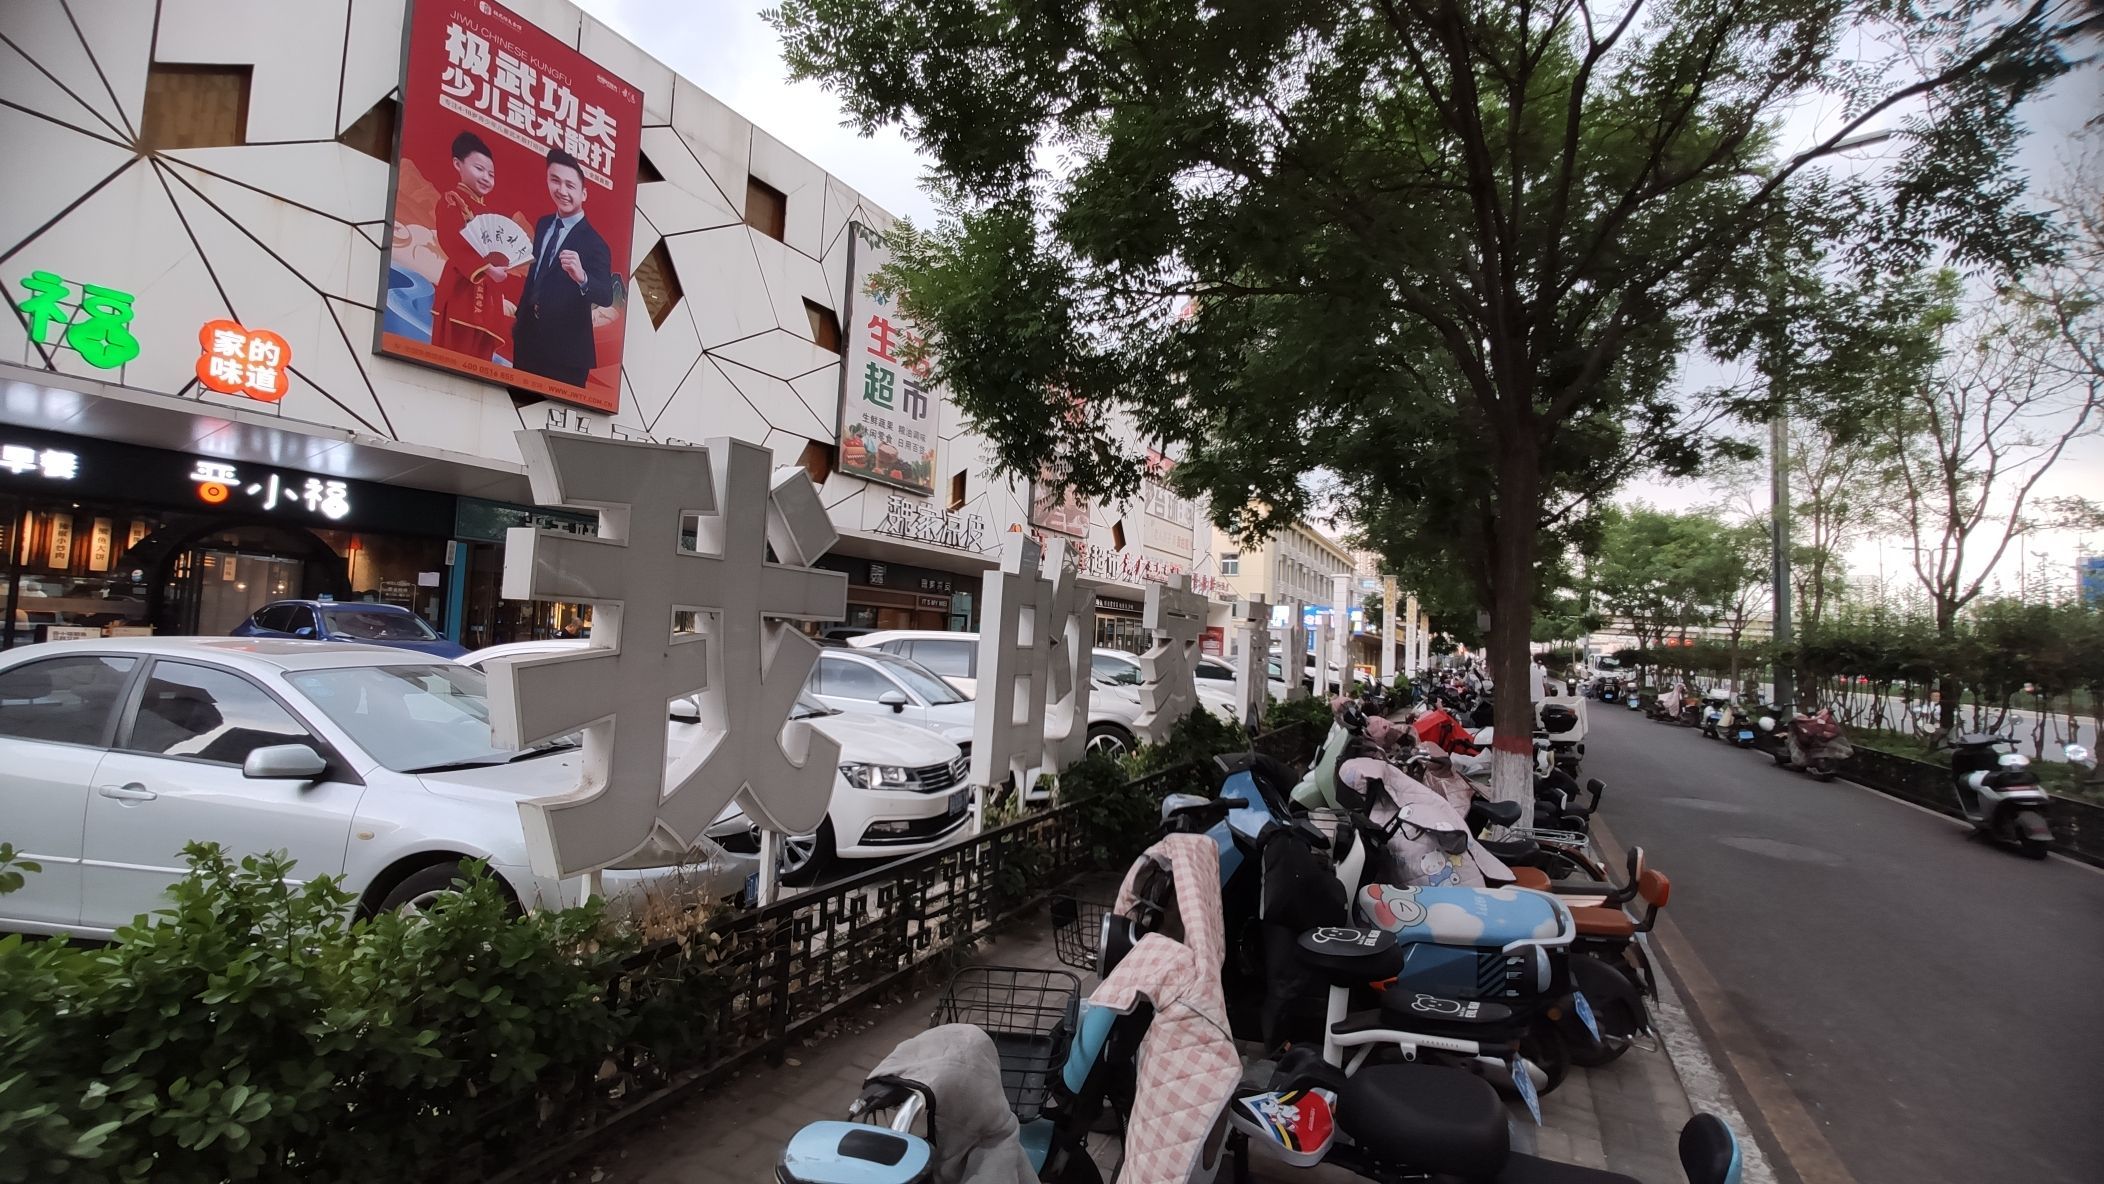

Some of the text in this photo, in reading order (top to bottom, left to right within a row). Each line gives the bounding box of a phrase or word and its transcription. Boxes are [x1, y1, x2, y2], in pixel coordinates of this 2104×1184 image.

[449, 10, 479, 32] JIWU
[480, 27, 528, 61] CHINESE
[530, 55, 573, 87] KUNGFU
[444, 22, 617, 151] 极武功夫
[440, 66, 616, 176] 少儿武术散打
[18, 270, 141, 370] 福
[211, 329, 281, 365] 家的
[208, 356, 279, 394] 味道
[862, 361, 929, 421] 超市
[0, 444, 81, 480] 早餐
[886, 495, 985, 554] 魏家凉皮
[482, 428, 850, 882] 我
